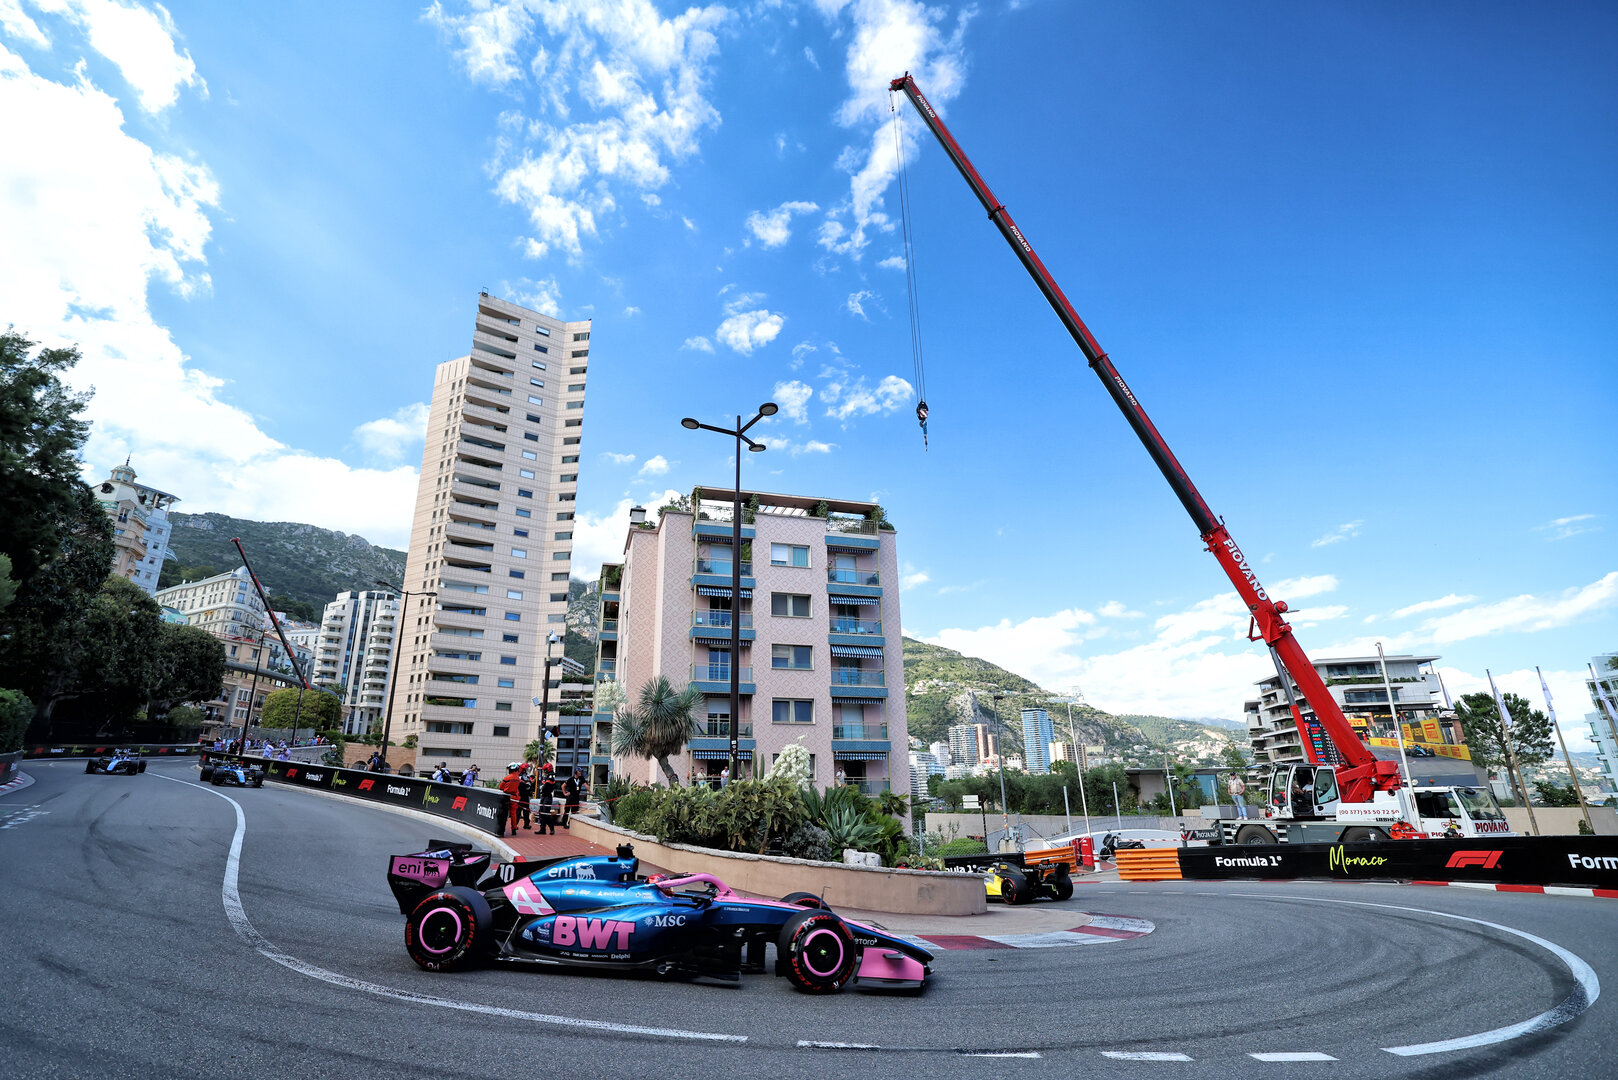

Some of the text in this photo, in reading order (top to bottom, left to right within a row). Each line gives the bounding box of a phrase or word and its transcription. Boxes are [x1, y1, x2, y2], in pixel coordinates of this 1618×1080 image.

[917, 94, 936, 119] PIOVANO
[1010, 225, 1031, 252] PIOVANO
[1114, 375, 1138, 406] PIOVANO
[1223, 538, 1268, 601] PIOVANO
[387, 784, 405, 796] Formula
[476, 803, 492, 819] Formula
[1475, 821, 1509, 833] PIOVANO
[398, 861, 421, 874] eni
[1216, 857, 1268, 867] Formula
[1329, 844, 1388, 875] Monaco
[1445, 850, 1504, 869] F1
[1567, 853, 1618, 870] Form
[500, 864, 515, 883] 10
[548, 863, 573, 878] eni
[654, 915, 686, 926] MSC
[465, 914, 475, 949] ZERO
[553, 915, 636, 951] BWT
